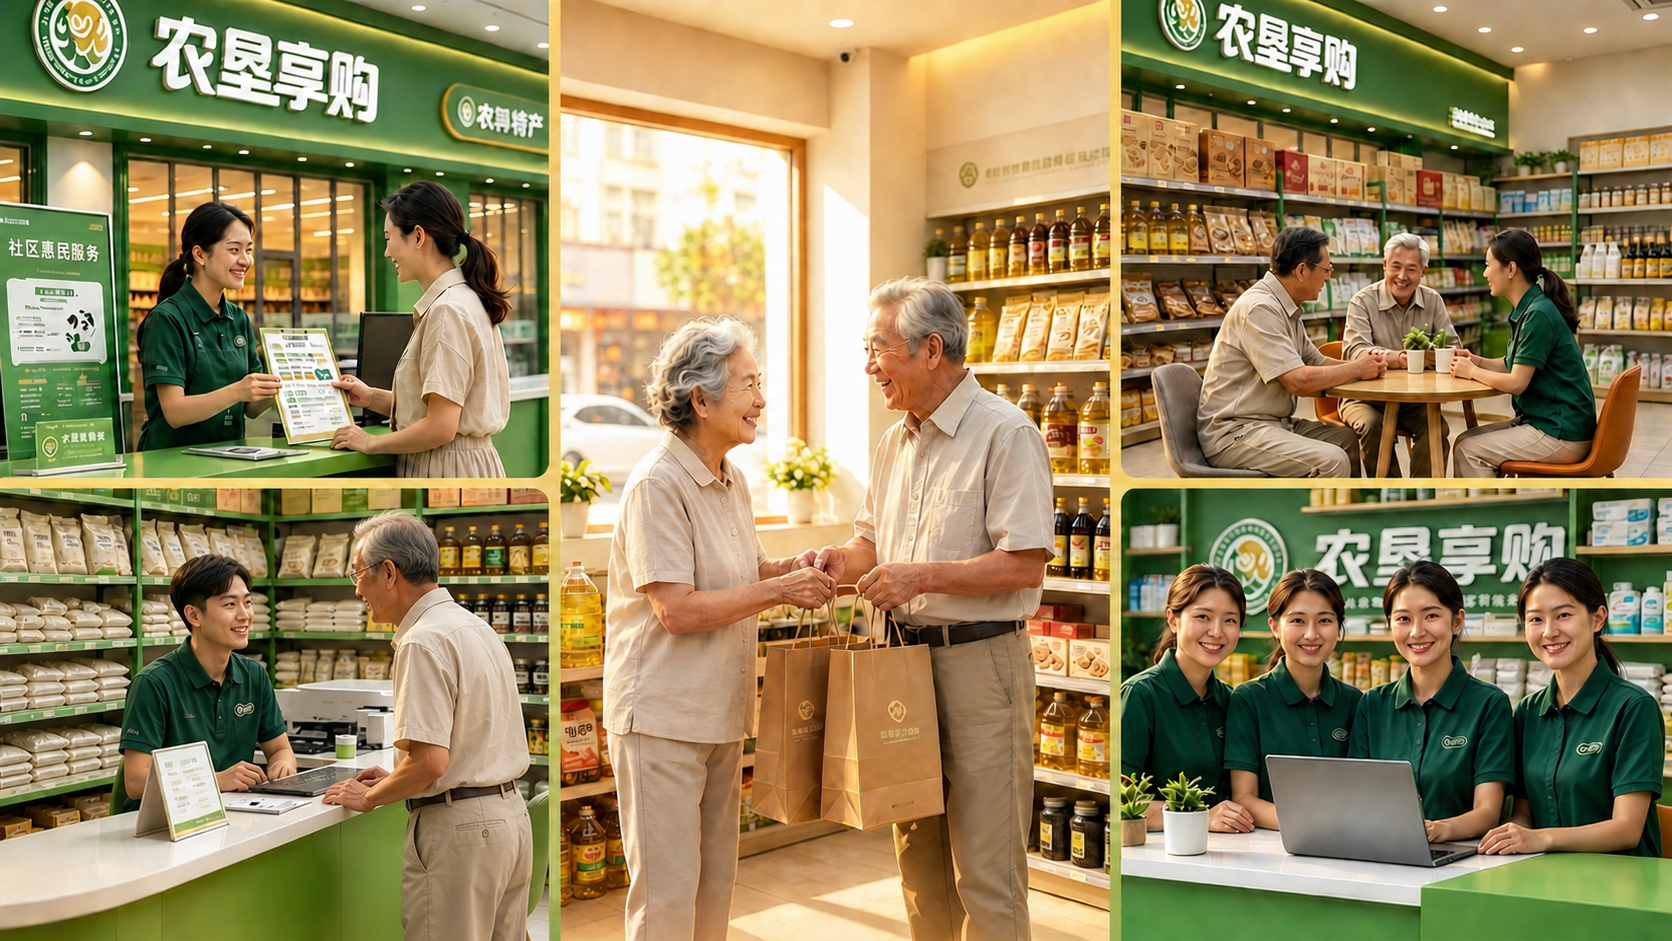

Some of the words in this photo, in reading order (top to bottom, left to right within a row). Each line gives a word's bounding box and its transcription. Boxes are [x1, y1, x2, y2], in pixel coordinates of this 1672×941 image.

[149, 16, 379, 123] 农垦享购
[1213, 3, 1357, 90] 农垦享购
[8, 238, 99, 262] 社区惠民服务
[1314, 522, 1566, 588] 农垦享购
